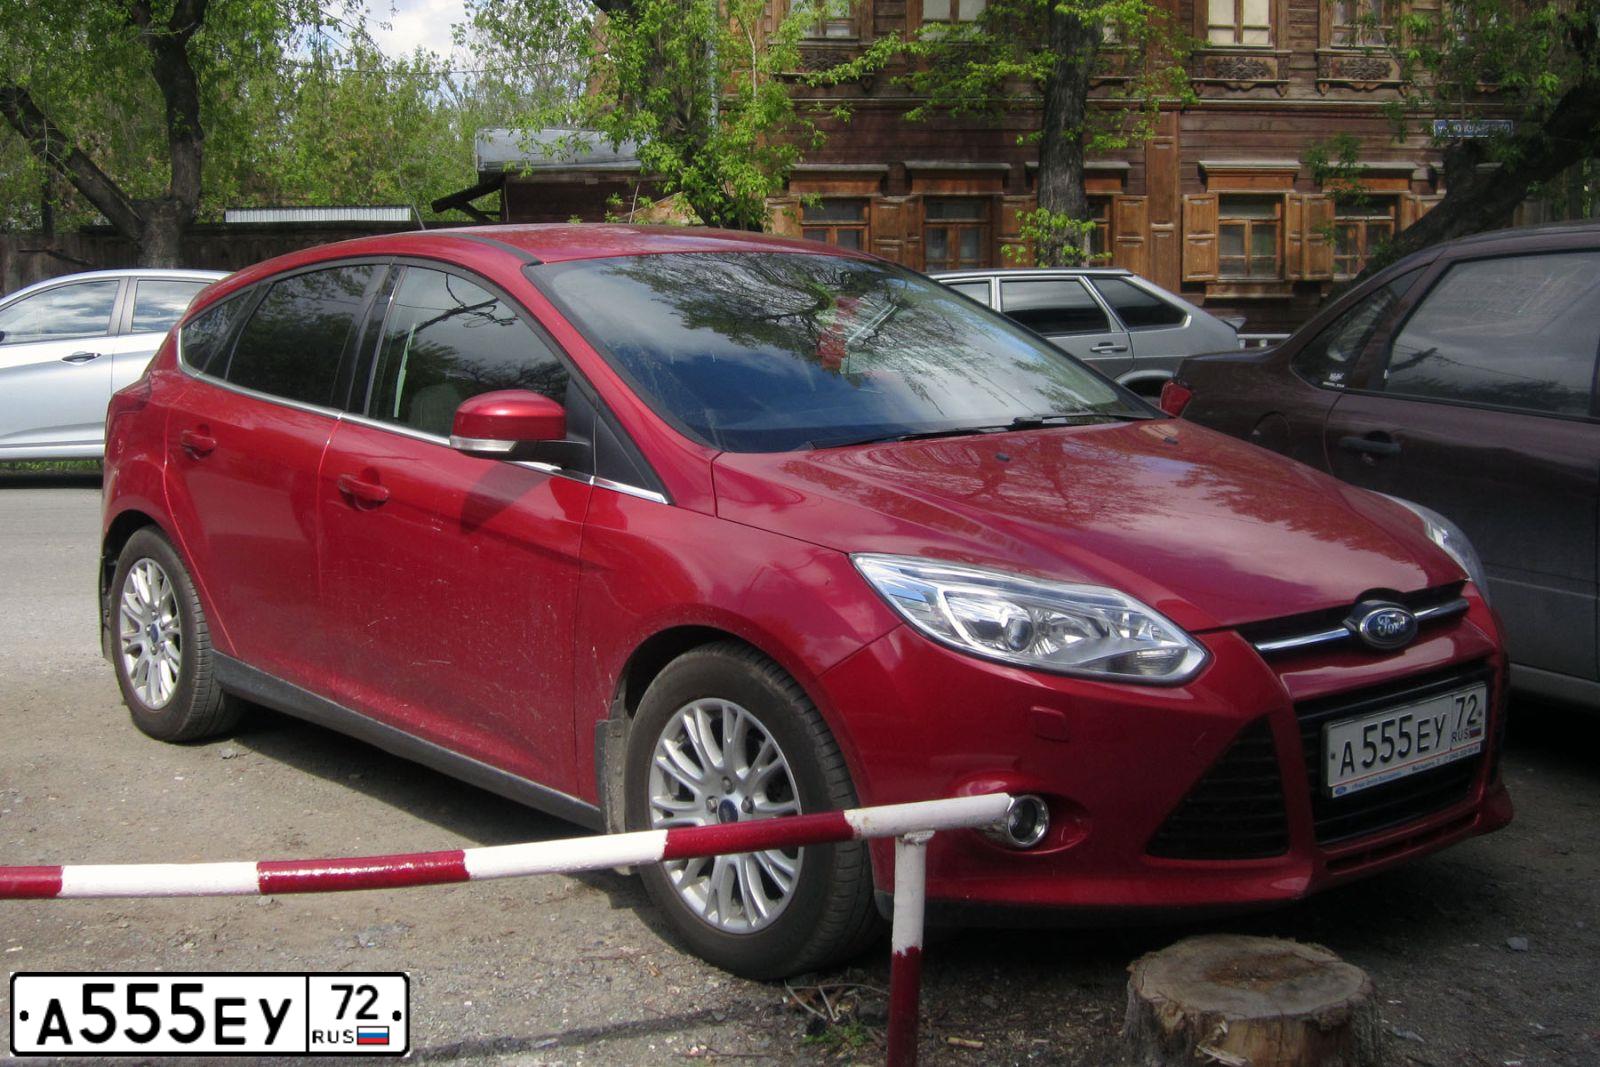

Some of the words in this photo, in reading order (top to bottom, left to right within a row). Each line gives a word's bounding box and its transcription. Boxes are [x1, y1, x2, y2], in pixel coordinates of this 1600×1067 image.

[1377, 613, 1406, 636] Ford
[1455, 694, 1478, 730] 72
[1451, 728, 1470, 743] RUS
